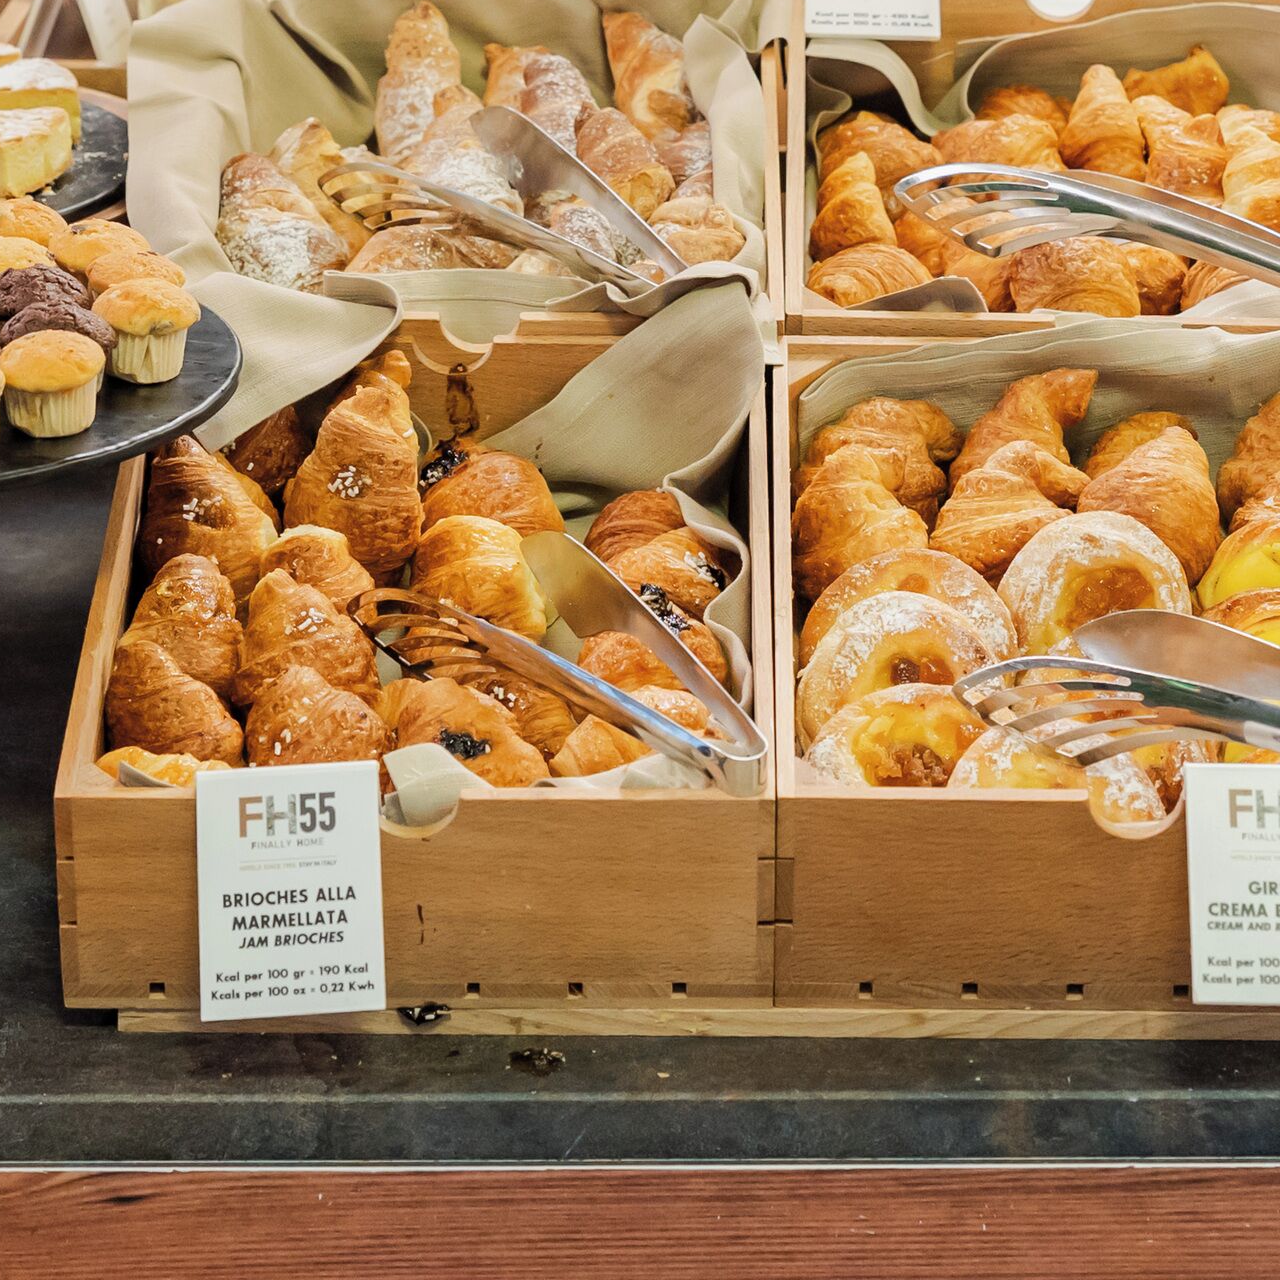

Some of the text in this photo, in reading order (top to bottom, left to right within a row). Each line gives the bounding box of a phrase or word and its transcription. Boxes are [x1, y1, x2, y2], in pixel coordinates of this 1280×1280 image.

[238, 791, 336, 838] FH55
[251, 837, 324, 850] FINALLY HOME
[222, 885, 356, 908] BRIOCHES ALLA
[1208, 902, 1268, 918] CREMA
[232, 909, 348, 931] MARMELLATA
[1207, 921, 1244, 931] CREAM
[1247, 921, 1271, 932] AND
[239, 931, 344, 949] JAM BRIOCHES
[1207, 956, 1232, 967] Kcal
[1236, 959, 1254, 969] per
[1259, 957, 1280, 968] 100
[216, 971, 240, 983] Kcal
[244, 973, 263, 983] per
[268, 968, 288, 979] 100
[293, 970, 305, 980] gr
[319, 965, 340, 976] 190
[344, 963, 369, 974] Kcal
[1202, 973, 1232, 984] Kcals
[1236, 976, 1255, 986] per
[1259, 974, 1280, 985] 100
[211, 989, 240, 1001] Kcals
[244, 990, 263, 1001] per
[268, 986, 289, 997] 100
[293, 987, 306, 995] oz
[320, 982, 344, 995] 0,22
[348, 980, 375, 991] Kwh
